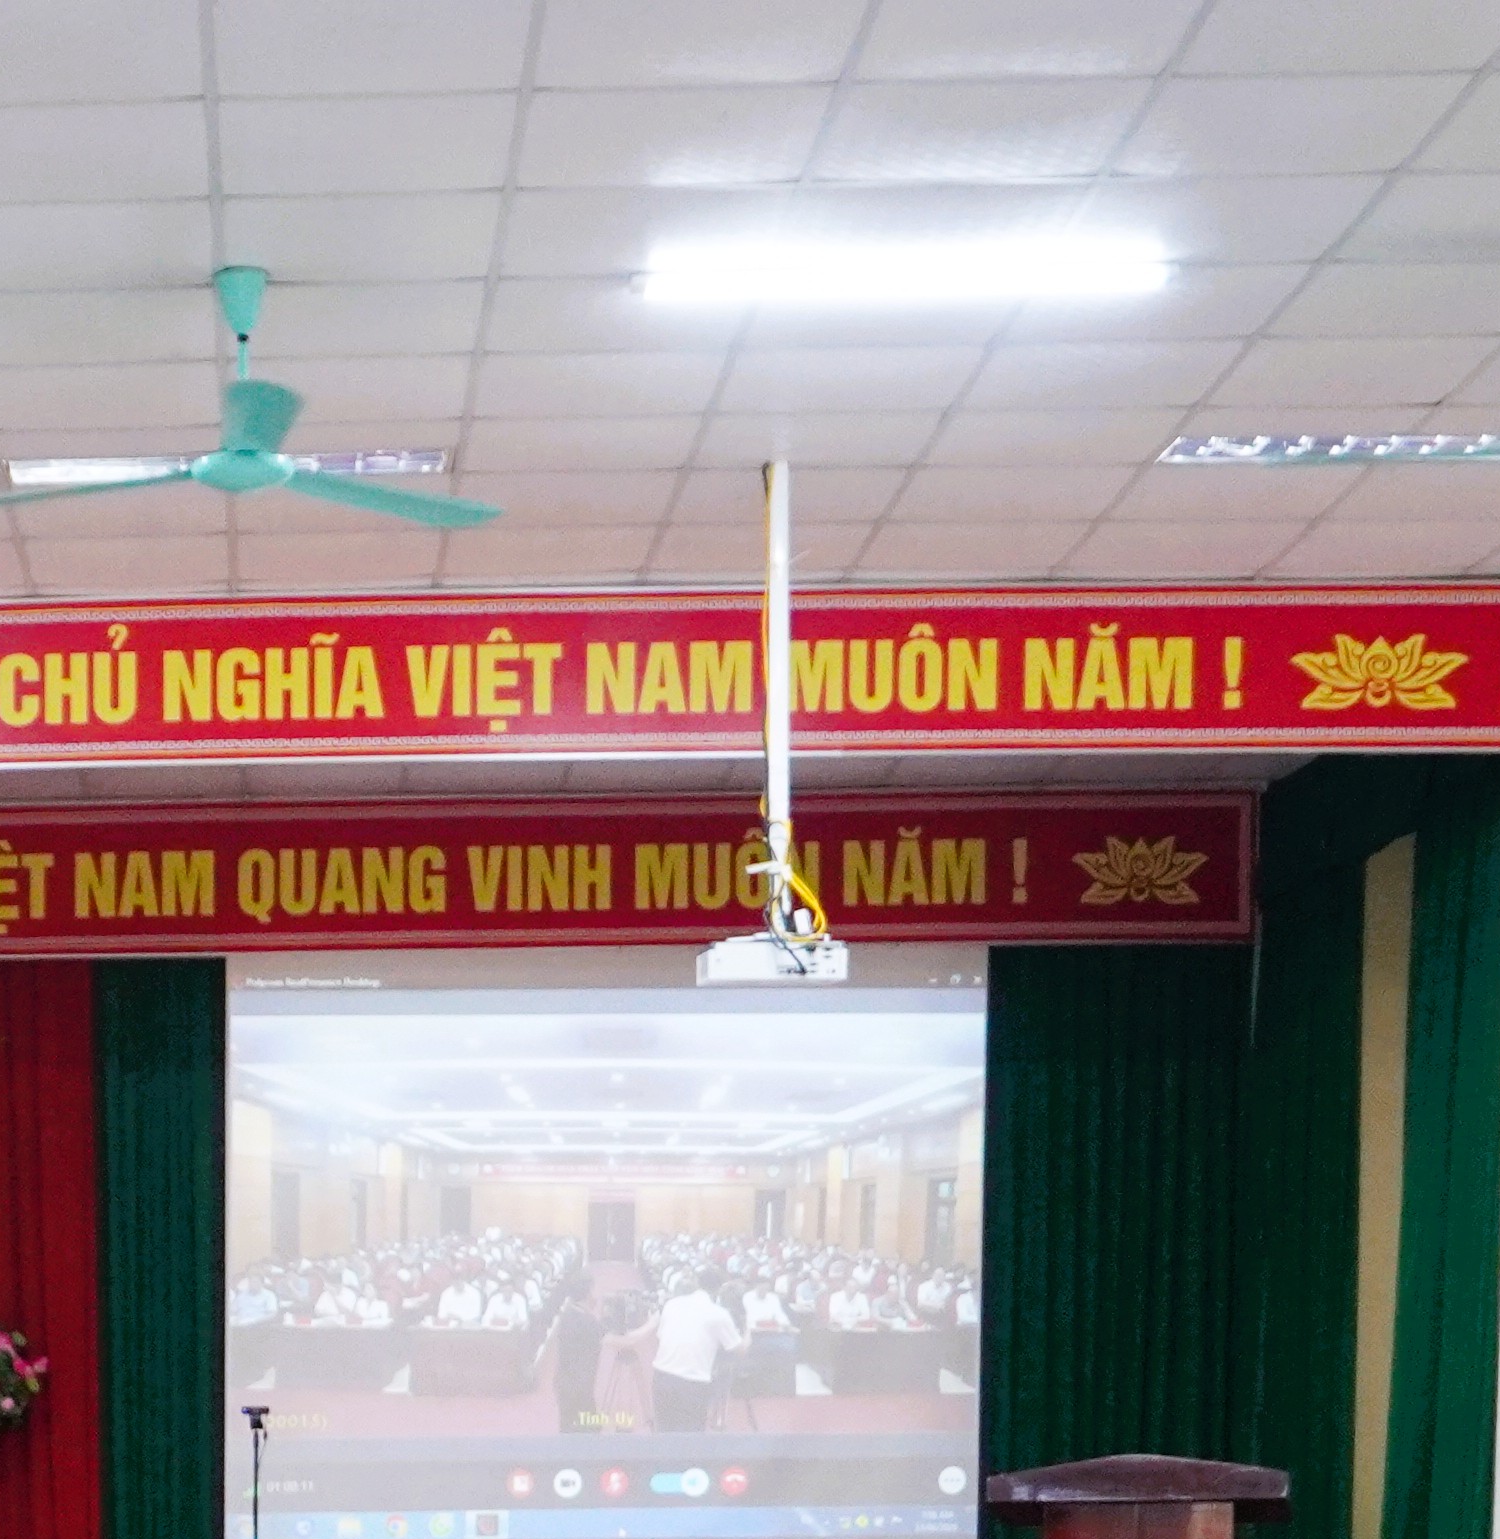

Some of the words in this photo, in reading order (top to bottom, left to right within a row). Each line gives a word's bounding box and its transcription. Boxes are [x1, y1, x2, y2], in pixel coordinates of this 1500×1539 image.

[163, 633, 384, 720] NGHĨA
[408, 628, 561, 730] VIỆT
[588, 641, 752, 712] NAM
[791, 622, 998, 714] MUÔN
[1024, 625, 1194, 710] NĂM
[1224, 638, 1243, 708] !
[71, 848, 216, 918] NAM
[236, 845, 448, 925] QUANG
[468, 842, 613, 912] VINH
[842, 826, 987, 907] NĂM
[1012, 837, 1028, 904] !
